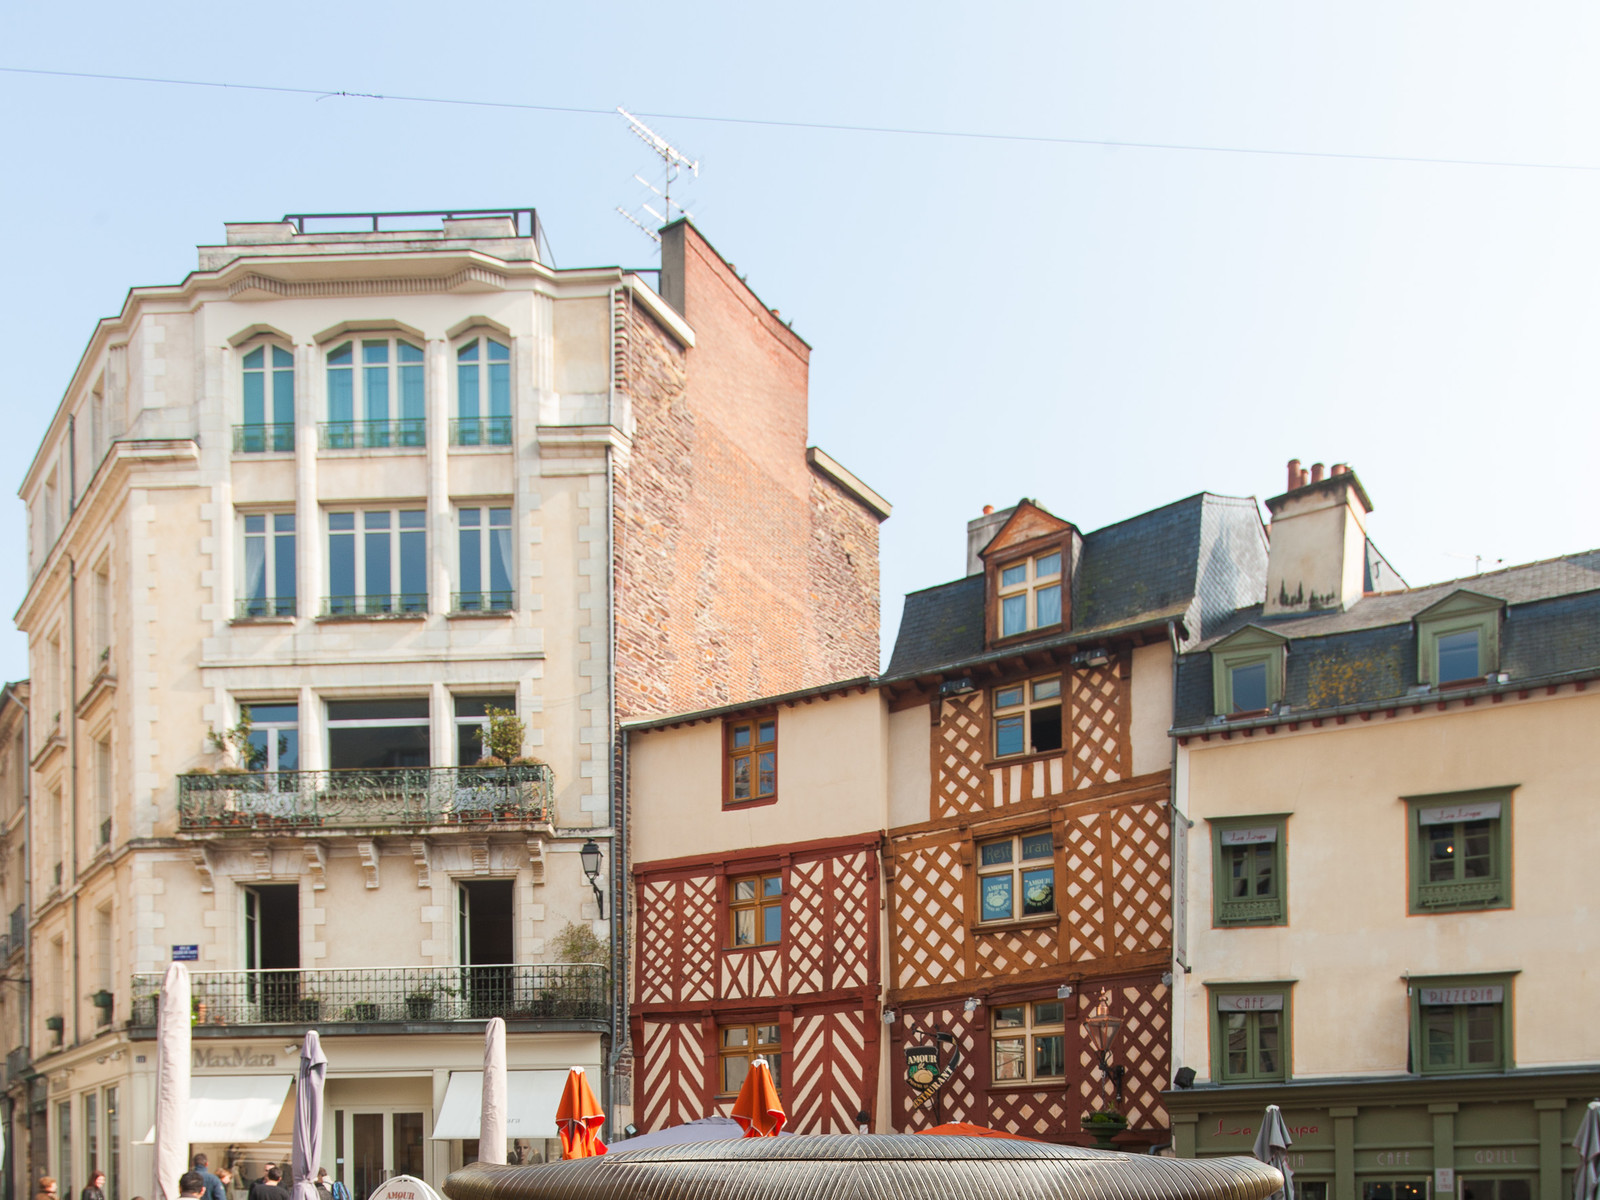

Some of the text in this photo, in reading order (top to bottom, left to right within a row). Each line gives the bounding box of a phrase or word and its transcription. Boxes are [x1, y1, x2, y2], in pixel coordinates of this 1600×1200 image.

[1430, 988, 1493, 1003] PIZZERIA
[193, 1045, 276, 1068] MaxMara
[908, 1054, 938, 1065] AMOUR
[1213, 1118, 1319, 1139] La upa
[1474, 1149, 1518, 1164] GRILL
[386, 1191, 415, 1200] AMOUR
